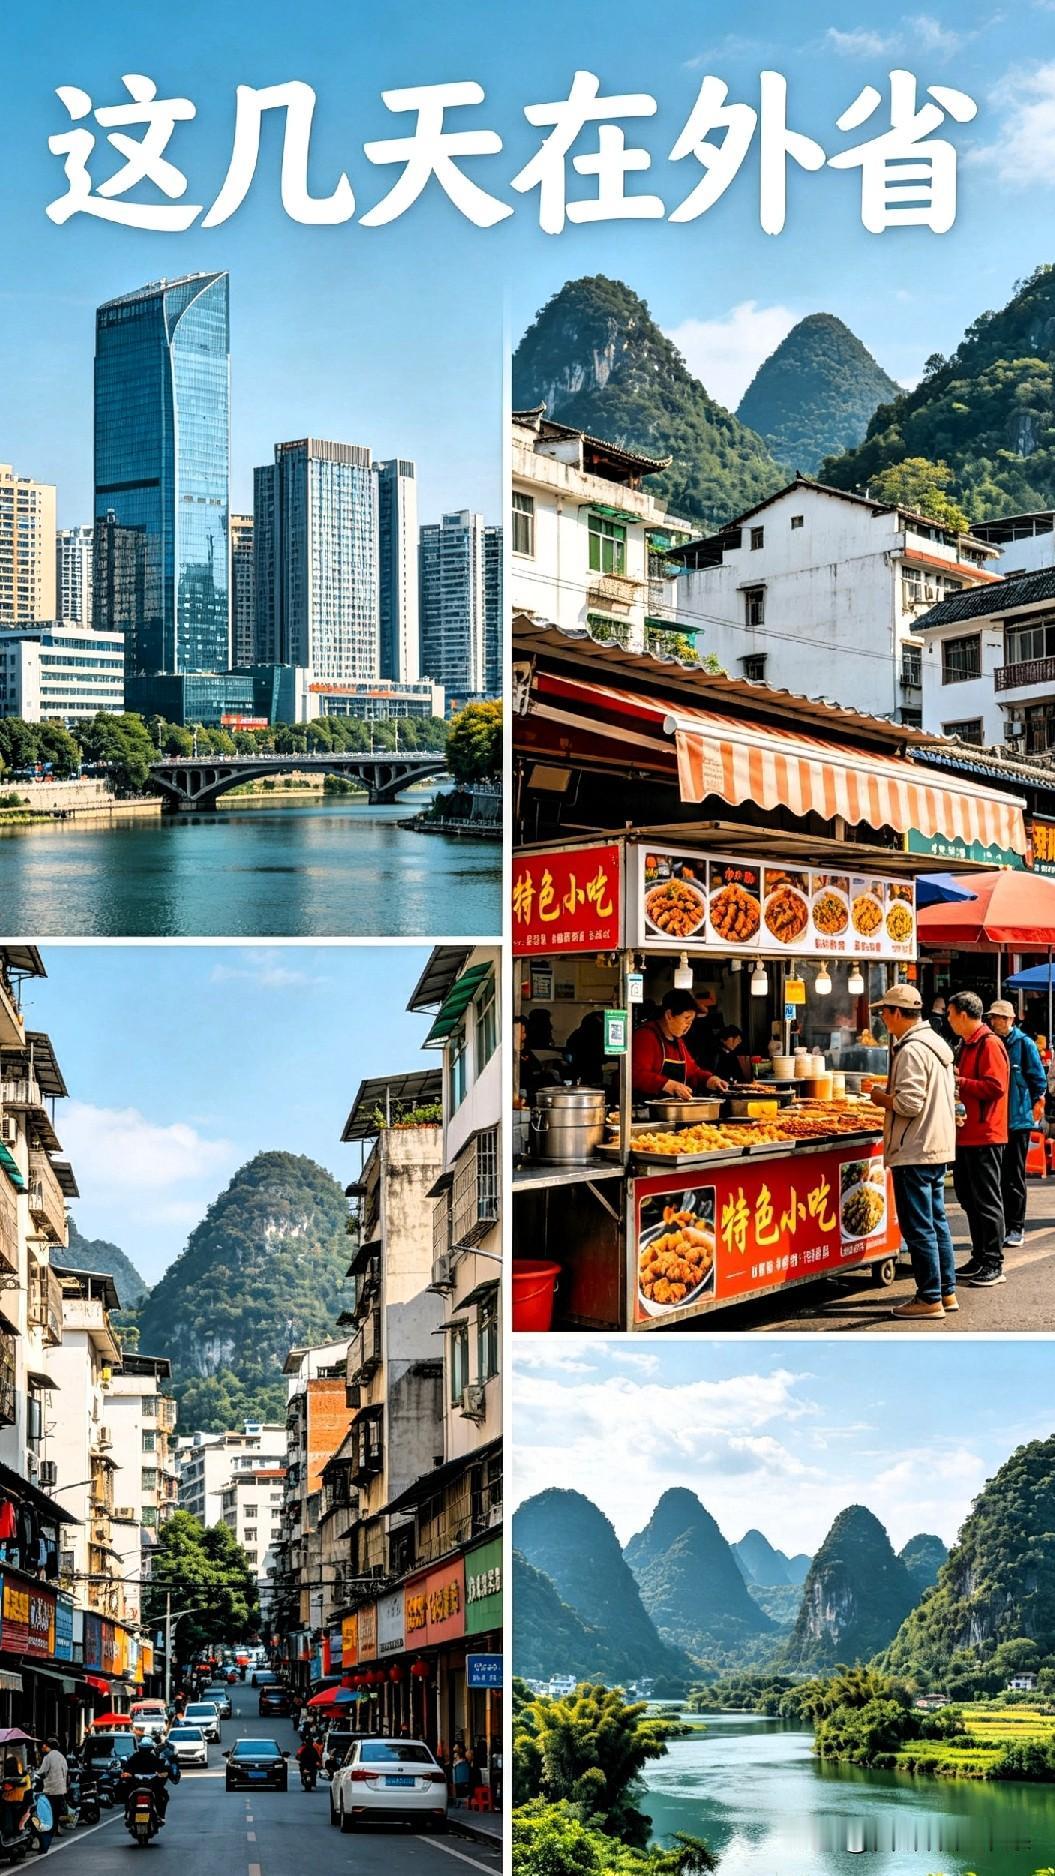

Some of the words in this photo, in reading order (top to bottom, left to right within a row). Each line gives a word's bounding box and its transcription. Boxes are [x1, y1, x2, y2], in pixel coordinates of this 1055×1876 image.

[513, 865, 613, 926] 特色小吃
[721, 1174, 836, 1255] 特色小吃
